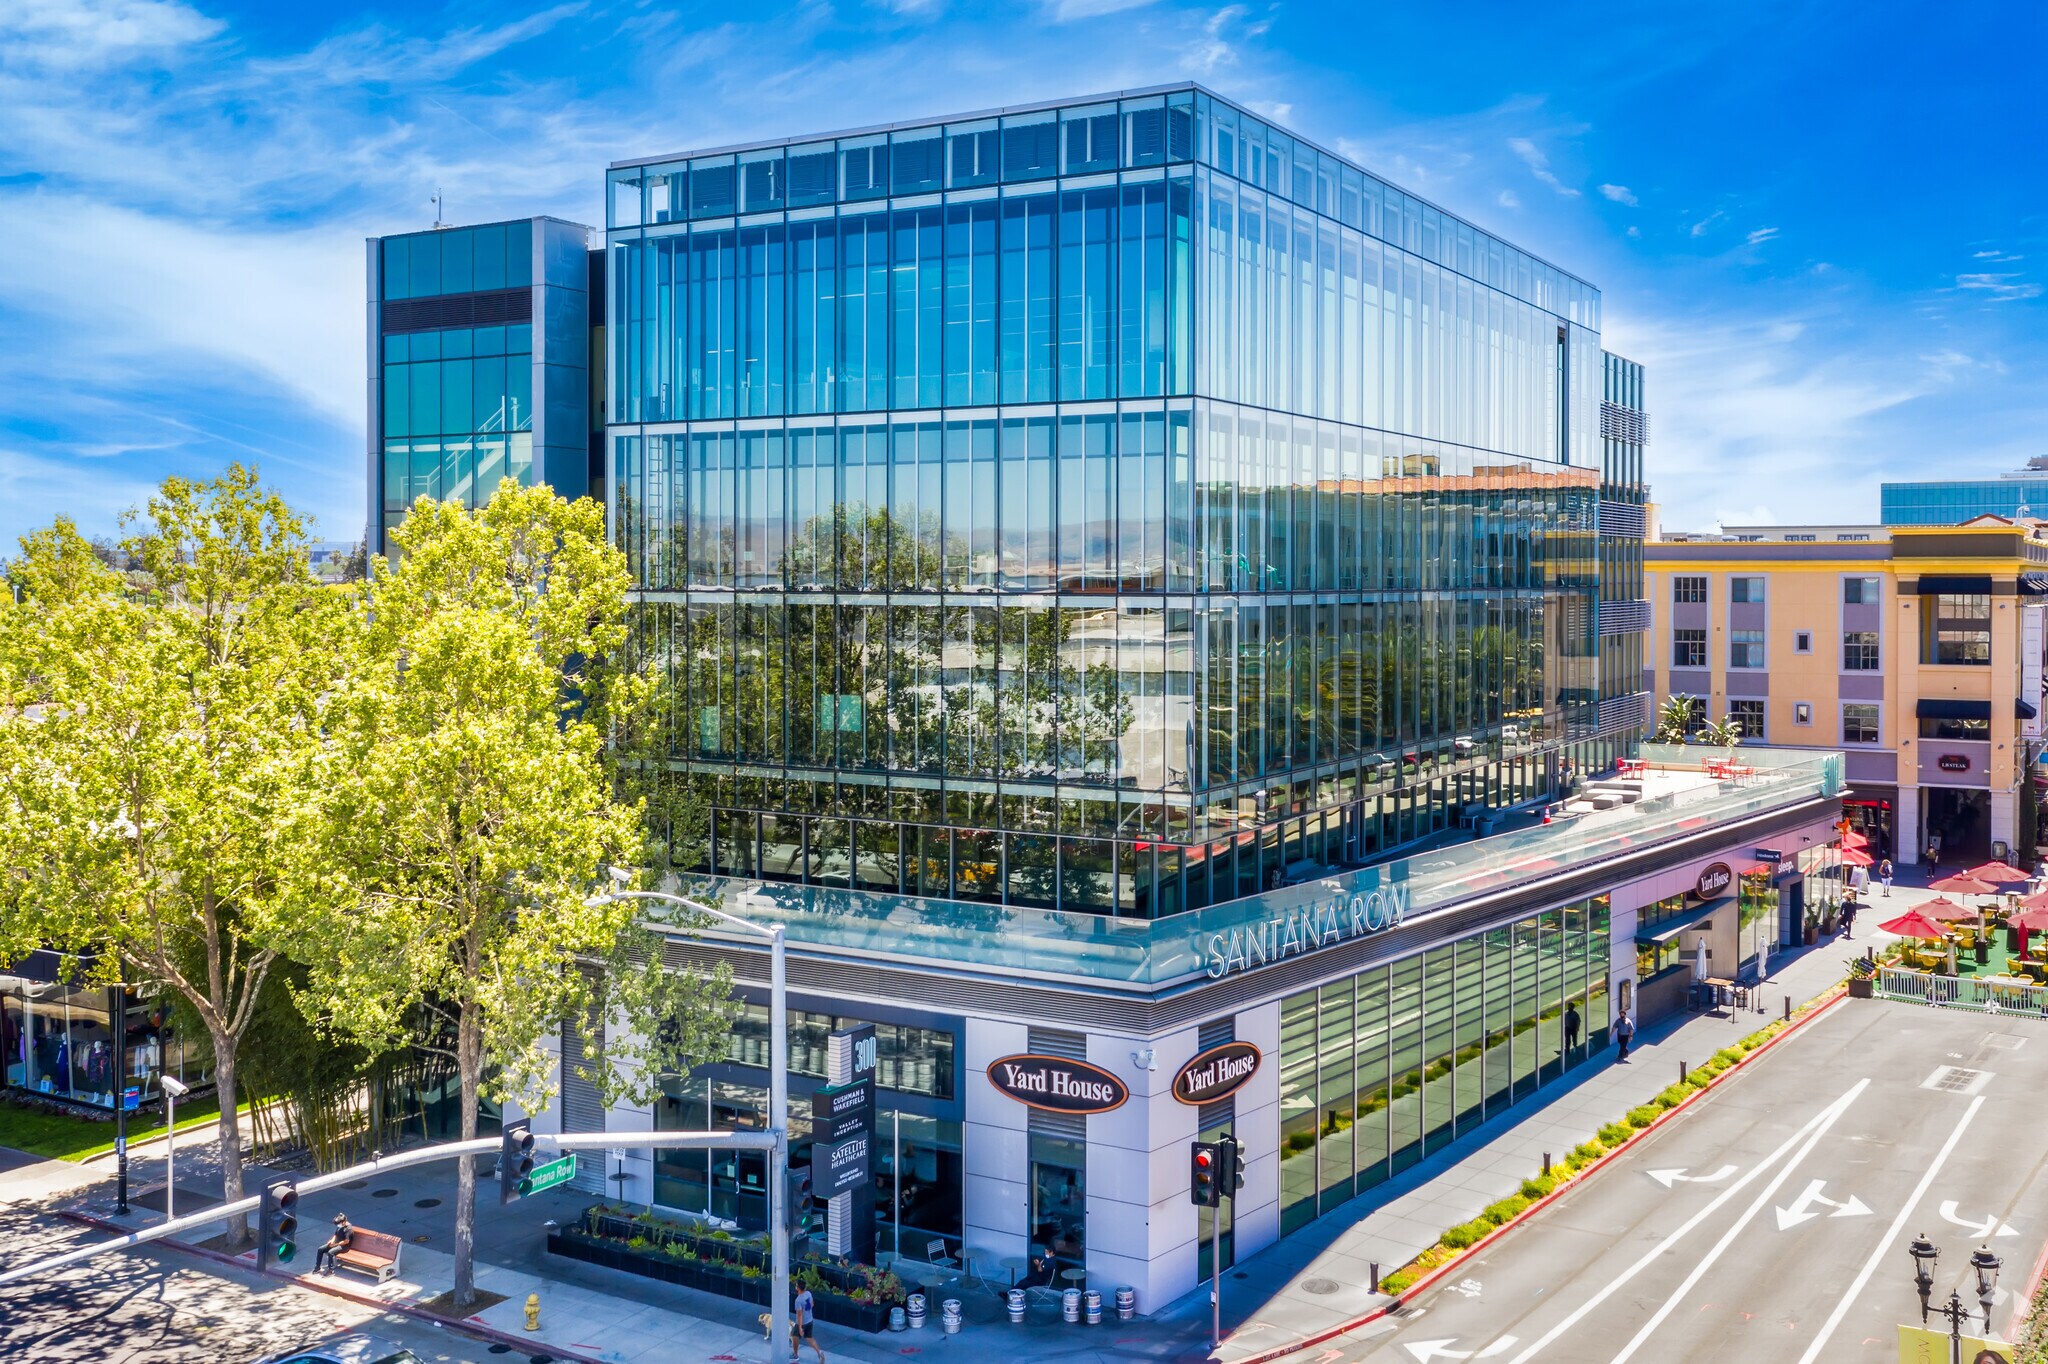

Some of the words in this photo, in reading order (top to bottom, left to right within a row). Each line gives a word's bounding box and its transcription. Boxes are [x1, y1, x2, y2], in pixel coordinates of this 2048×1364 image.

[1778, 860, 1794, 874] sleep.
[1701, 874, 1713, 892] Yard
[1714, 872, 1729, 888] House
[1207, 903, 1341, 979] SANTANA
[1351, 883, 1408, 937] ROW
[854, 1036, 876, 1073] 300
[1003, 1064, 1047, 1093] Yard
[1050, 1071, 1113, 1102] House
[1186, 1068, 1214, 1094] Yard
[1217, 1054, 1254, 1086] House
[833, 1090, 860, 1105] CUSHMAN
[833, 1096, 865, 1112] WAKEFIELD
[834, 1122, 863, 1137] INCEPTION
[838, 1118, 858, 1129] VALLEY
[832, 1140, 867, 1162] SATELLITE
[832, 1149, 866, 1169] HEALTHCARE
[532, 1170, 555, 1187] antana
[556, 1164, 572, 1178] Row
